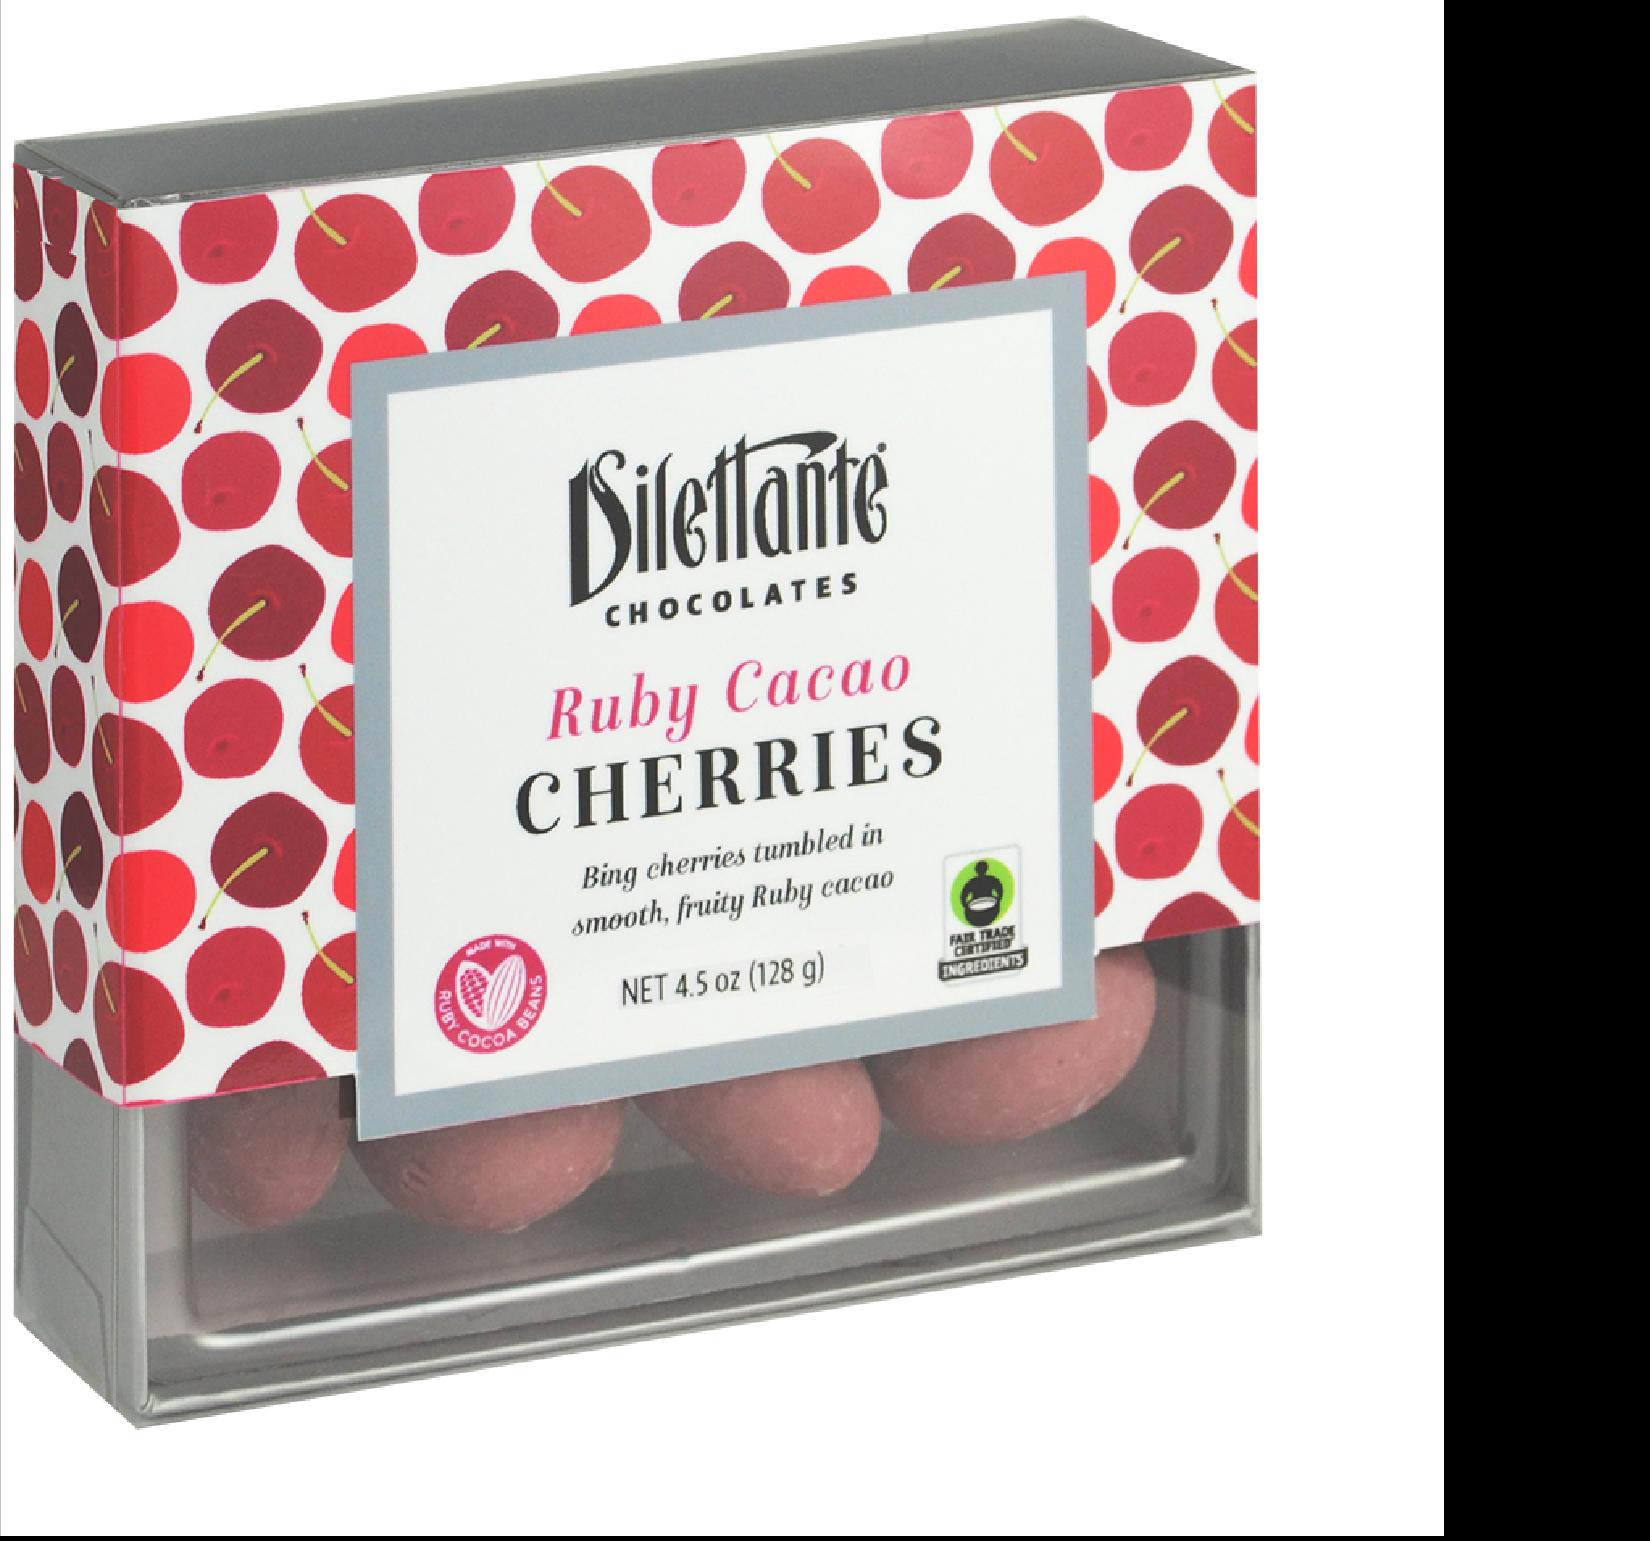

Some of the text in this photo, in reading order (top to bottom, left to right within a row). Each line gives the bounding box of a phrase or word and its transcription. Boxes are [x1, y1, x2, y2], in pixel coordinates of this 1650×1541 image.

[605, 573, 858, 627] CHOCOLATES
[547, 654, 911, 743] Ruby Cacao
[515, 716, 942, 835] CHERRIES
[581, 823, 884, 893] Bing cherries tumbled in
[571, 869, 895, 937] smooth, fruity Ruby cacao
[621, 950, 825, 1006] NET 4.5 oz (128 g)
